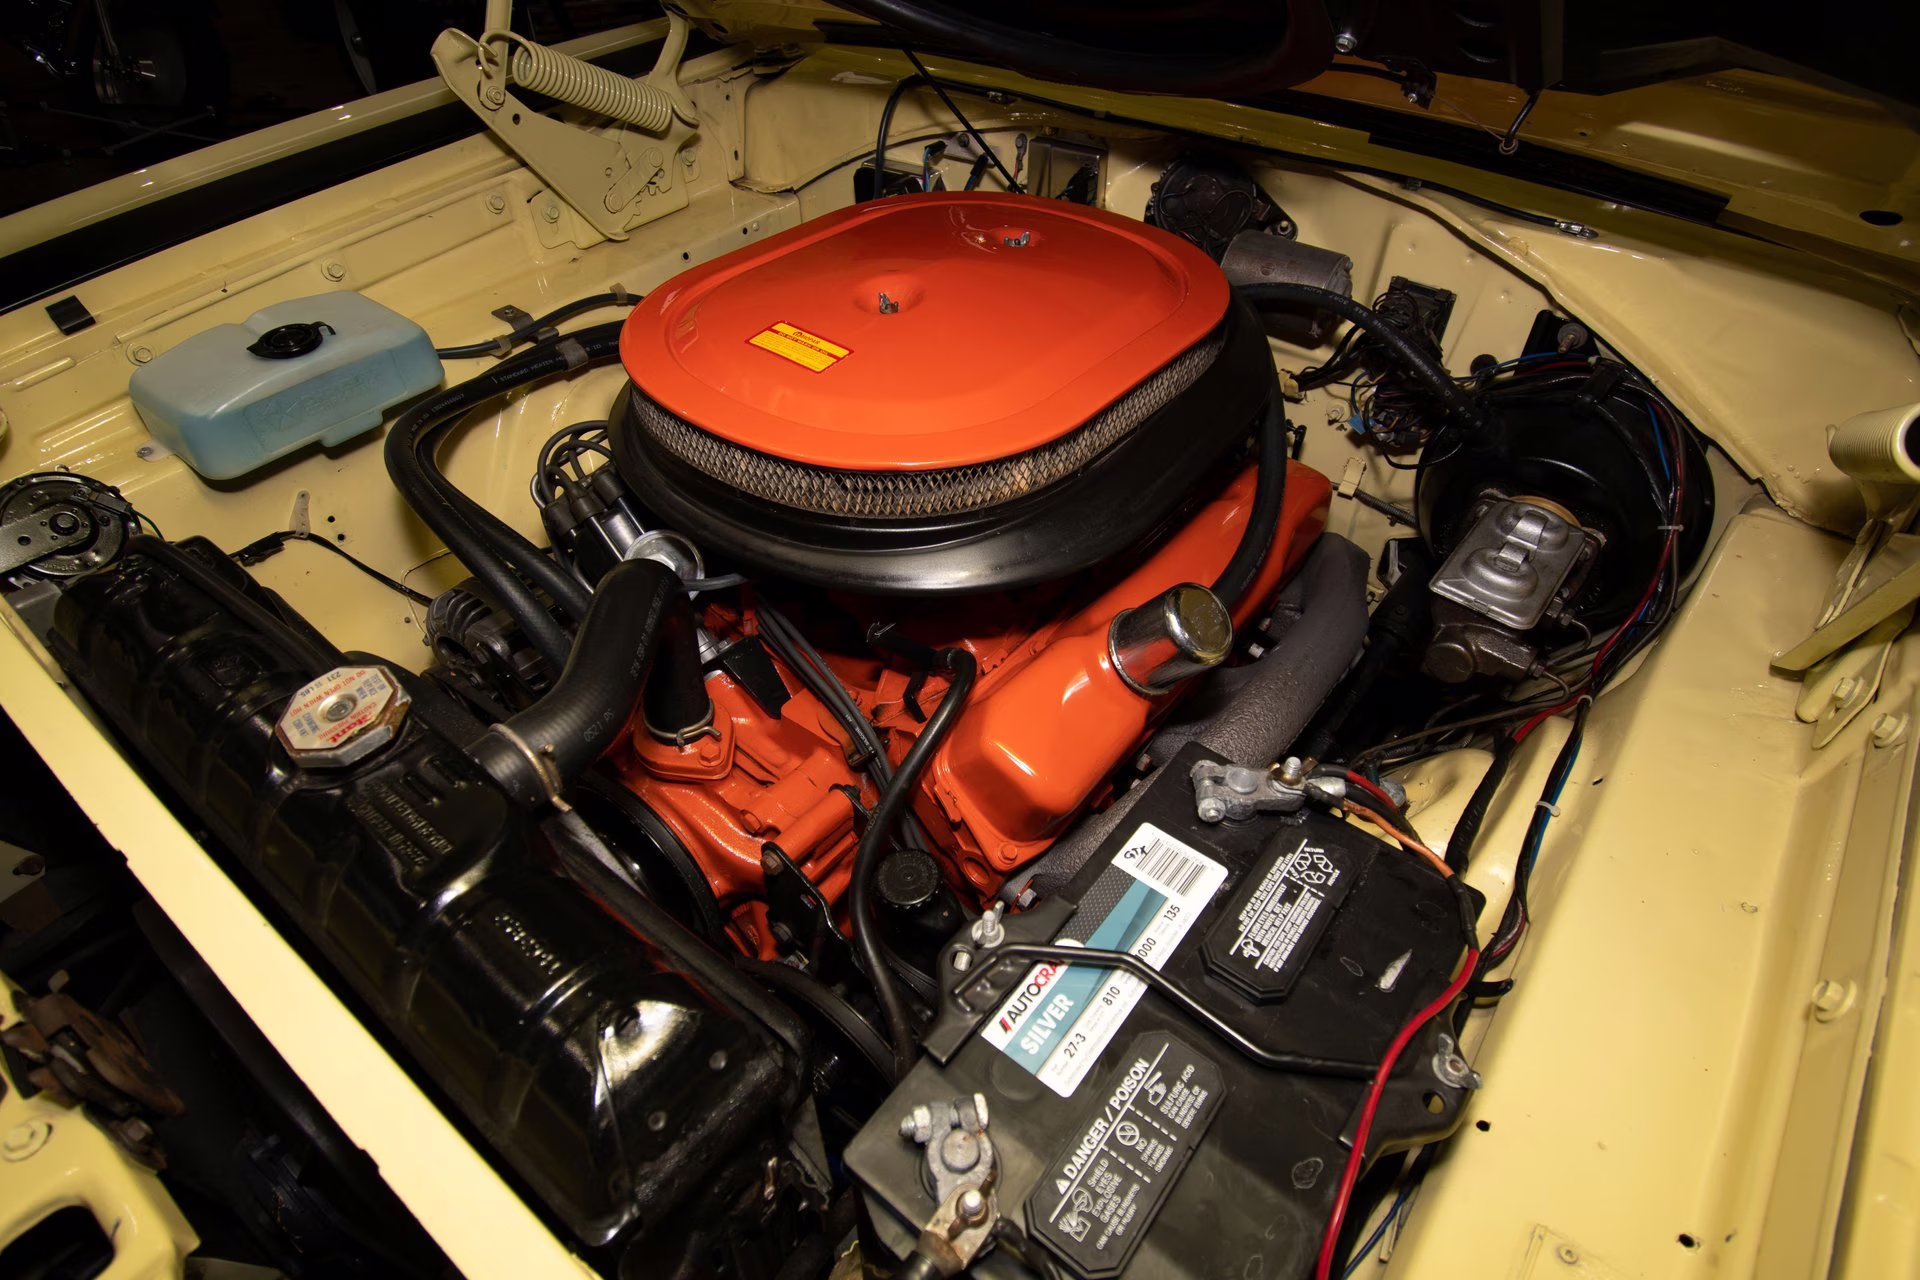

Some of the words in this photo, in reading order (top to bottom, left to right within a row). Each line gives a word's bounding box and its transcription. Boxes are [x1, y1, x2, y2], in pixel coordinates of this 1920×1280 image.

[1062, 1031, 1087, 1059] 27-3
[1100, 984, 1121, 1007] 810
[1163, 903, 1181, 922] 135
[1017, 988, 1075, 1058] SILVER
[1158, 1079, 1186, 1115] SULFURIC
[1179, 1062, 1196, 1083] ACID
[1167, 1105, 1179, 1119] CAN
[1175, 1087, 1190, 1107] CAUSE
[1061, 1114, 1110, 1181] DANGER
[1107, 1055, 1150, 1111] POISON
[1134, 1137, 1148, 1152] NO
[1140, 1137, 1159, 1162] SPARKS
[1146, 1143, 1165, 1168] FLAMES
[1153, 1145, 1174, 1173] SMOKING
[1086, 1157, 1110, 1188] SHIELD
[1094, 1170, 1113, 1194] EYES
[1090, 1173, 1123, 1218] EXPLOSIVE
[1098, 1193, 1122, 1224] GASES
[1095, 1234, 1108, 1250] CAN
[1103, 1214, 1121, 1236] CAUSE
